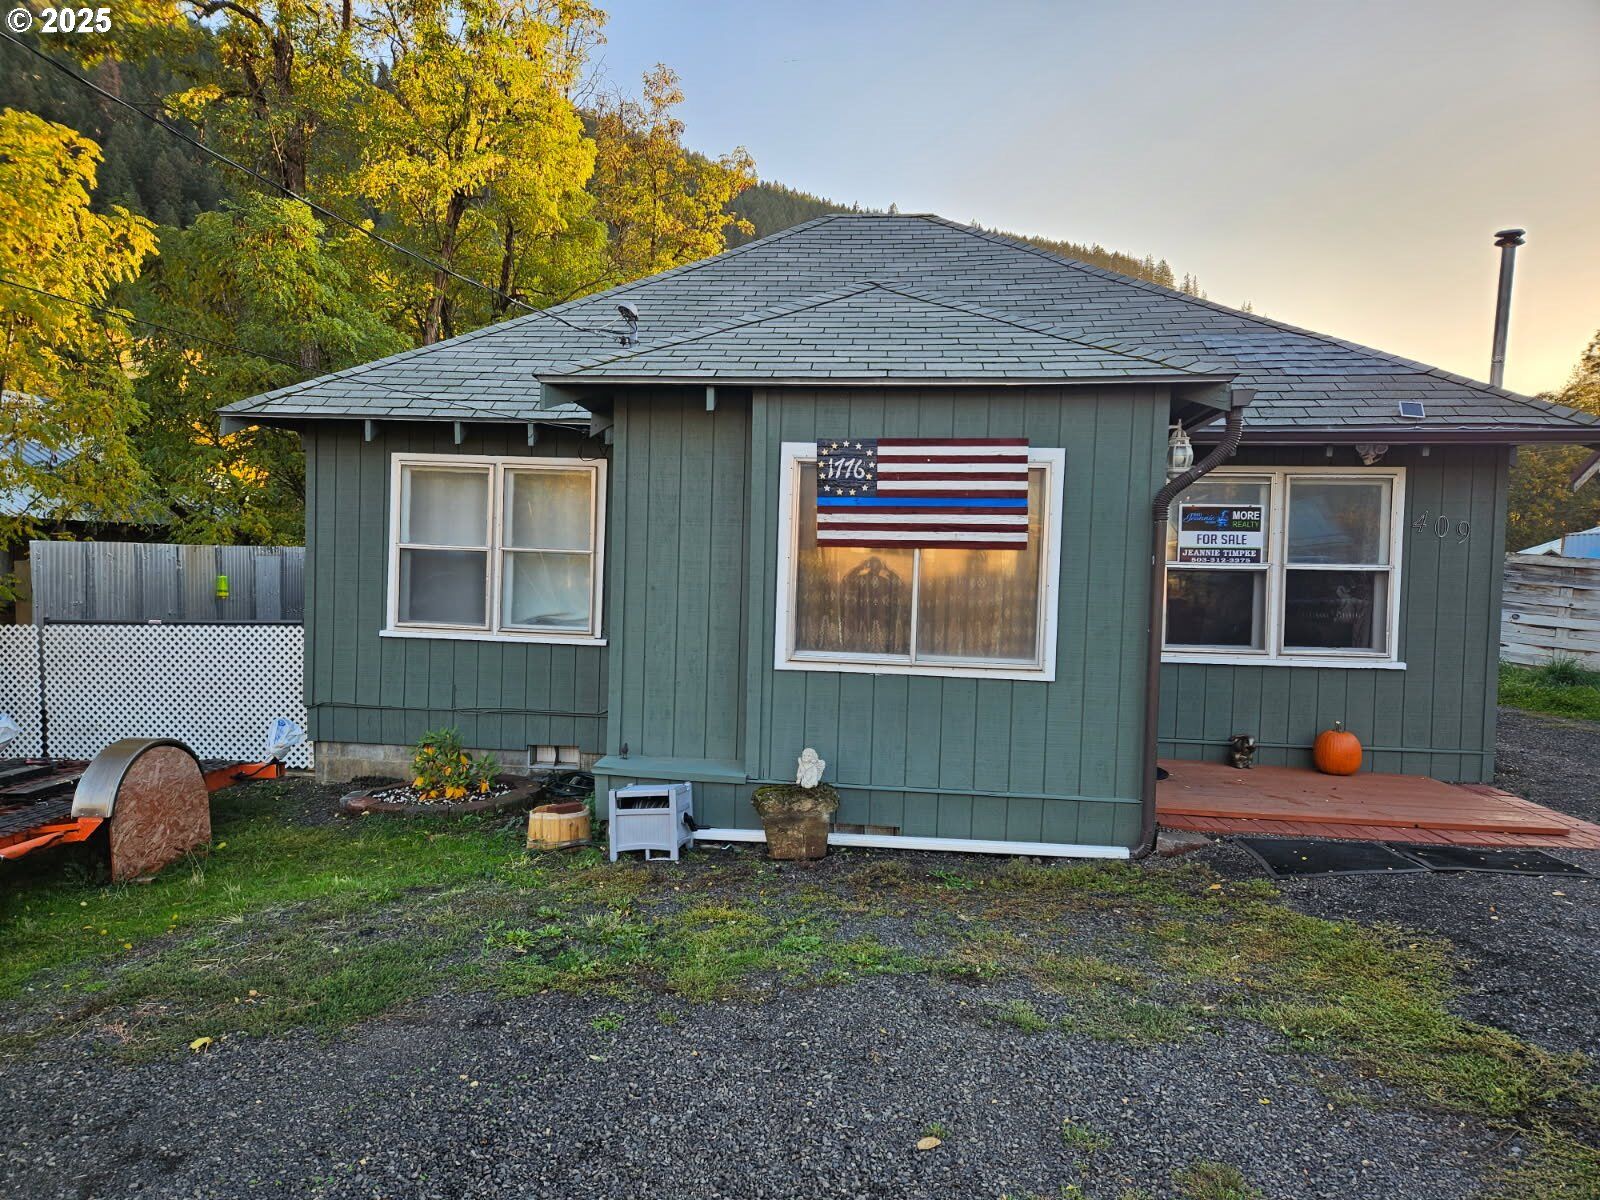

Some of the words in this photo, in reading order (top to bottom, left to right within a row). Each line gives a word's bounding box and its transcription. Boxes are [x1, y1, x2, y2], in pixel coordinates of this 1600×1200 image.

[828, 458, 866, 479] 1776
[1232, 511, 1260, 521] MORE
[1411, 510, 1471, 545] 409
[1196, 534, 1218, 545] FOR
[1221, 534, 1248, 545] SALE
[1182, 549, 1220, 557] JEANNIE
[1223, 549, 1257, 557] TIMPKE
